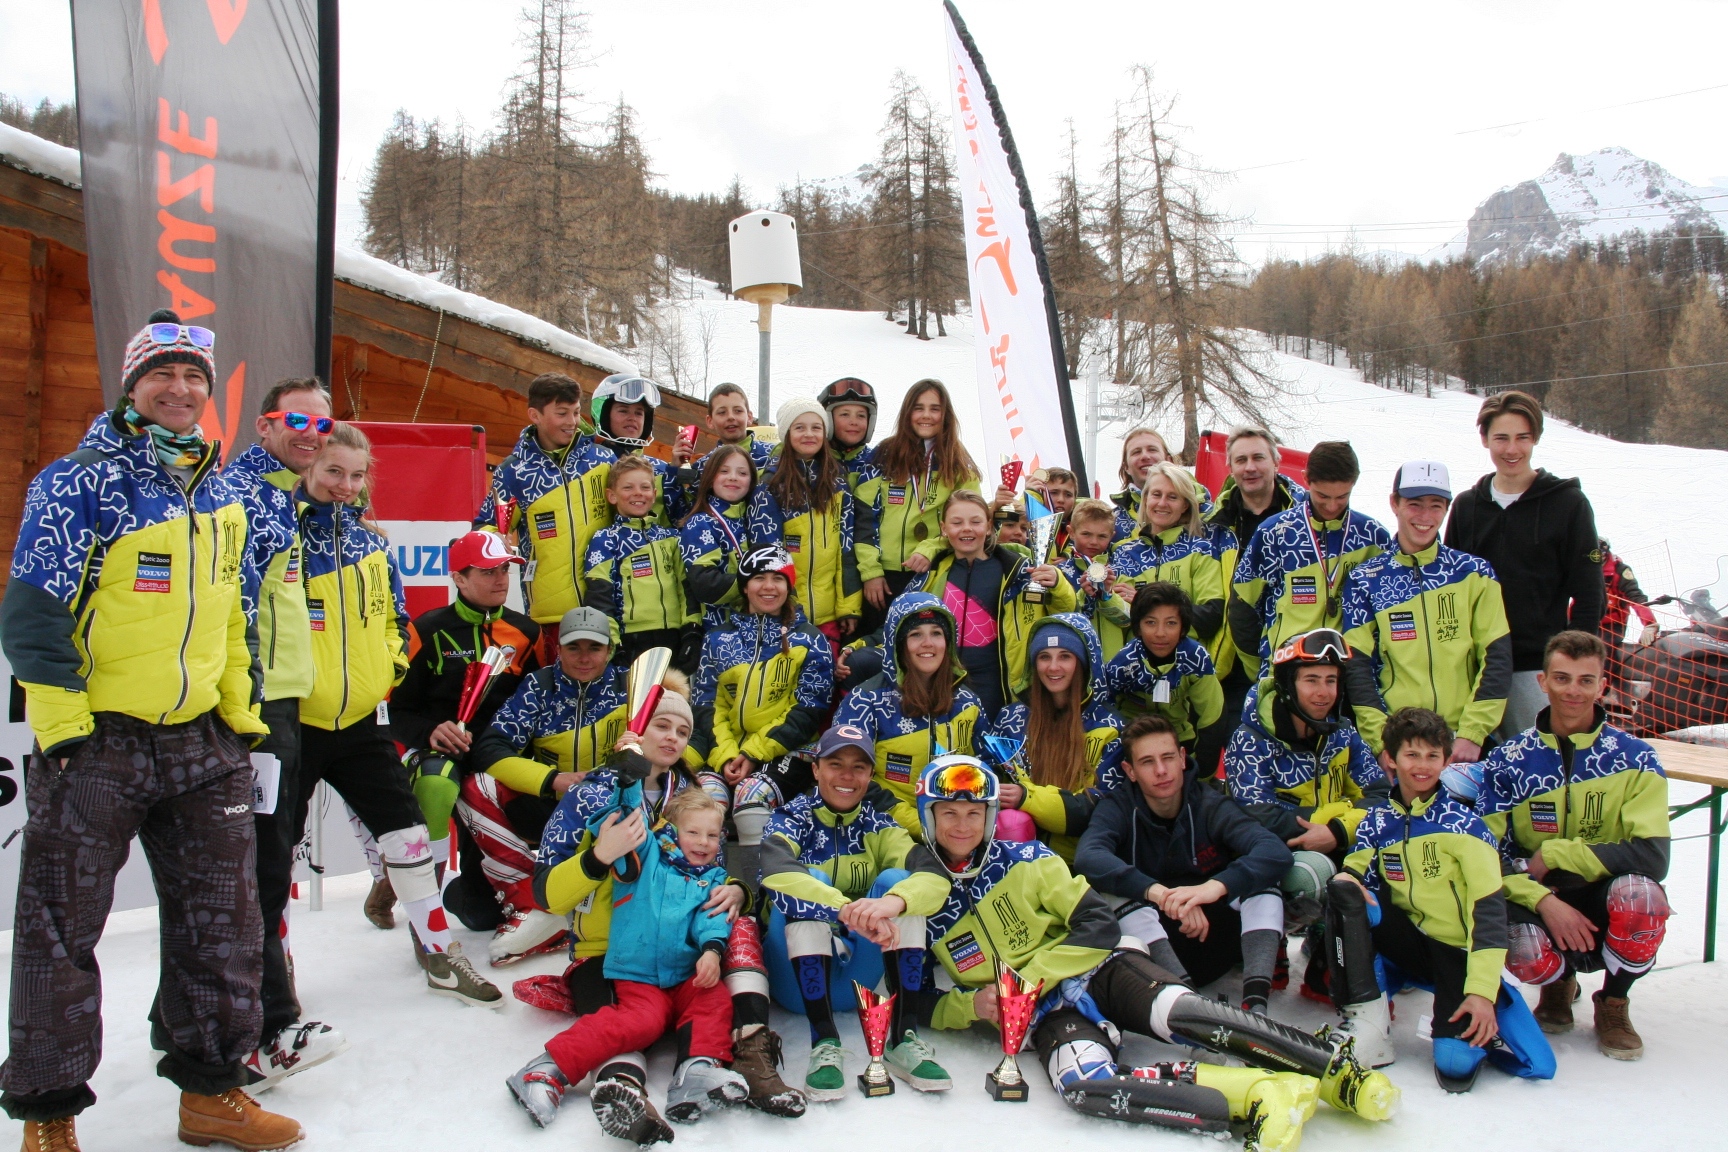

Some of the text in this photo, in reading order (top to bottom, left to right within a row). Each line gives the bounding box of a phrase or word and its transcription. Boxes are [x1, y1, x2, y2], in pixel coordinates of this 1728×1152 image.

[137, 569, 169, 577] VOLVO
[888, 765, 910, 773] VOLVO
[1003, 920, 1026, 936] CLUB
[953, 945, 978, 960] VOLVO
[803, 957, 820, 994] OCKS
[1144, 1106, 1196, 1120] ENERGIAPURA
